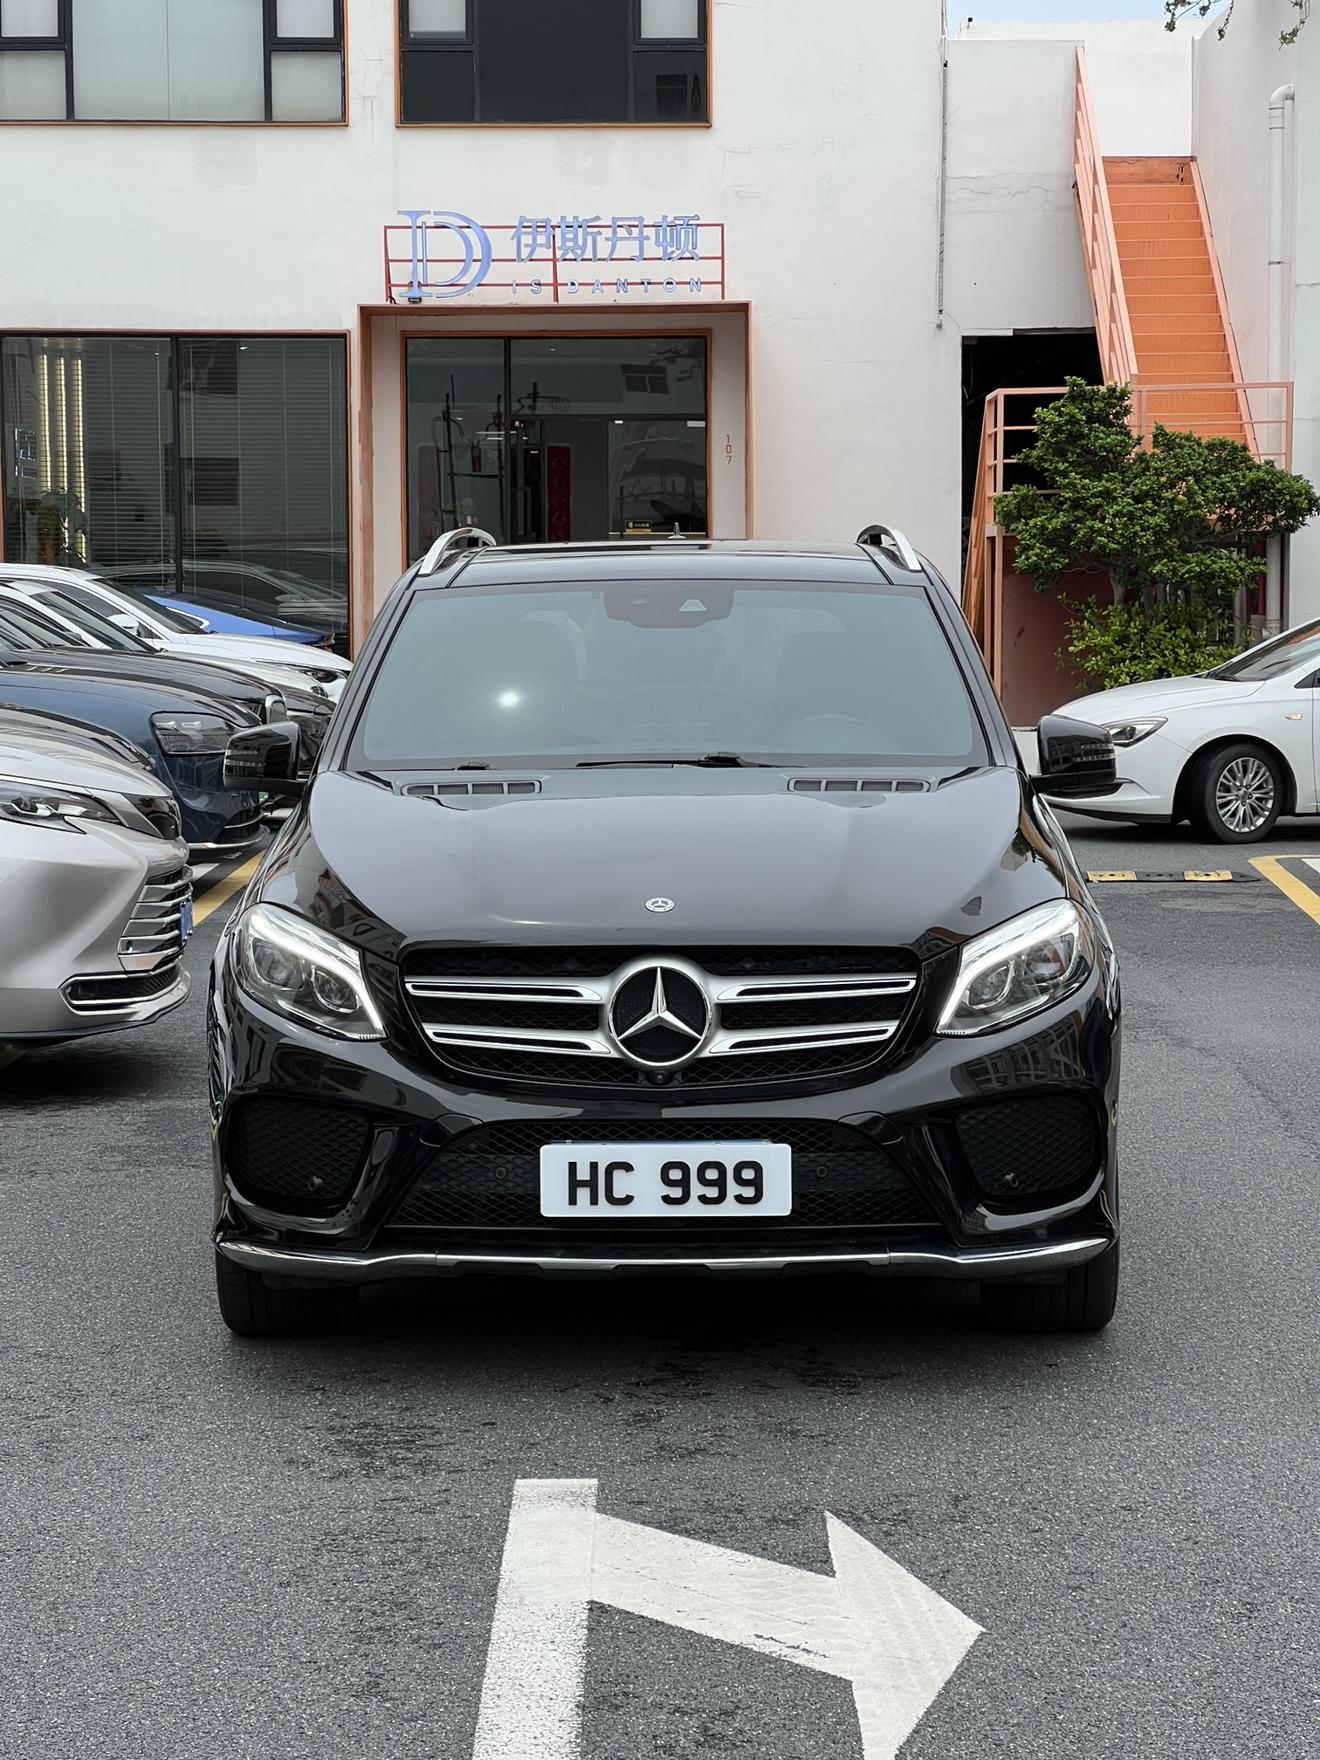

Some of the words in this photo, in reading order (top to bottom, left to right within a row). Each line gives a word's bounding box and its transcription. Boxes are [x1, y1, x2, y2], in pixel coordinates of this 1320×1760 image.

[510, 214, 701, 263] 伊斯丹顿
[511, 278, 542, 294] IS
[567, 277, 702, 294] DANTON
[568, 1161, 635, 1206] HC
[660, 1160, 764, 1206] 999
